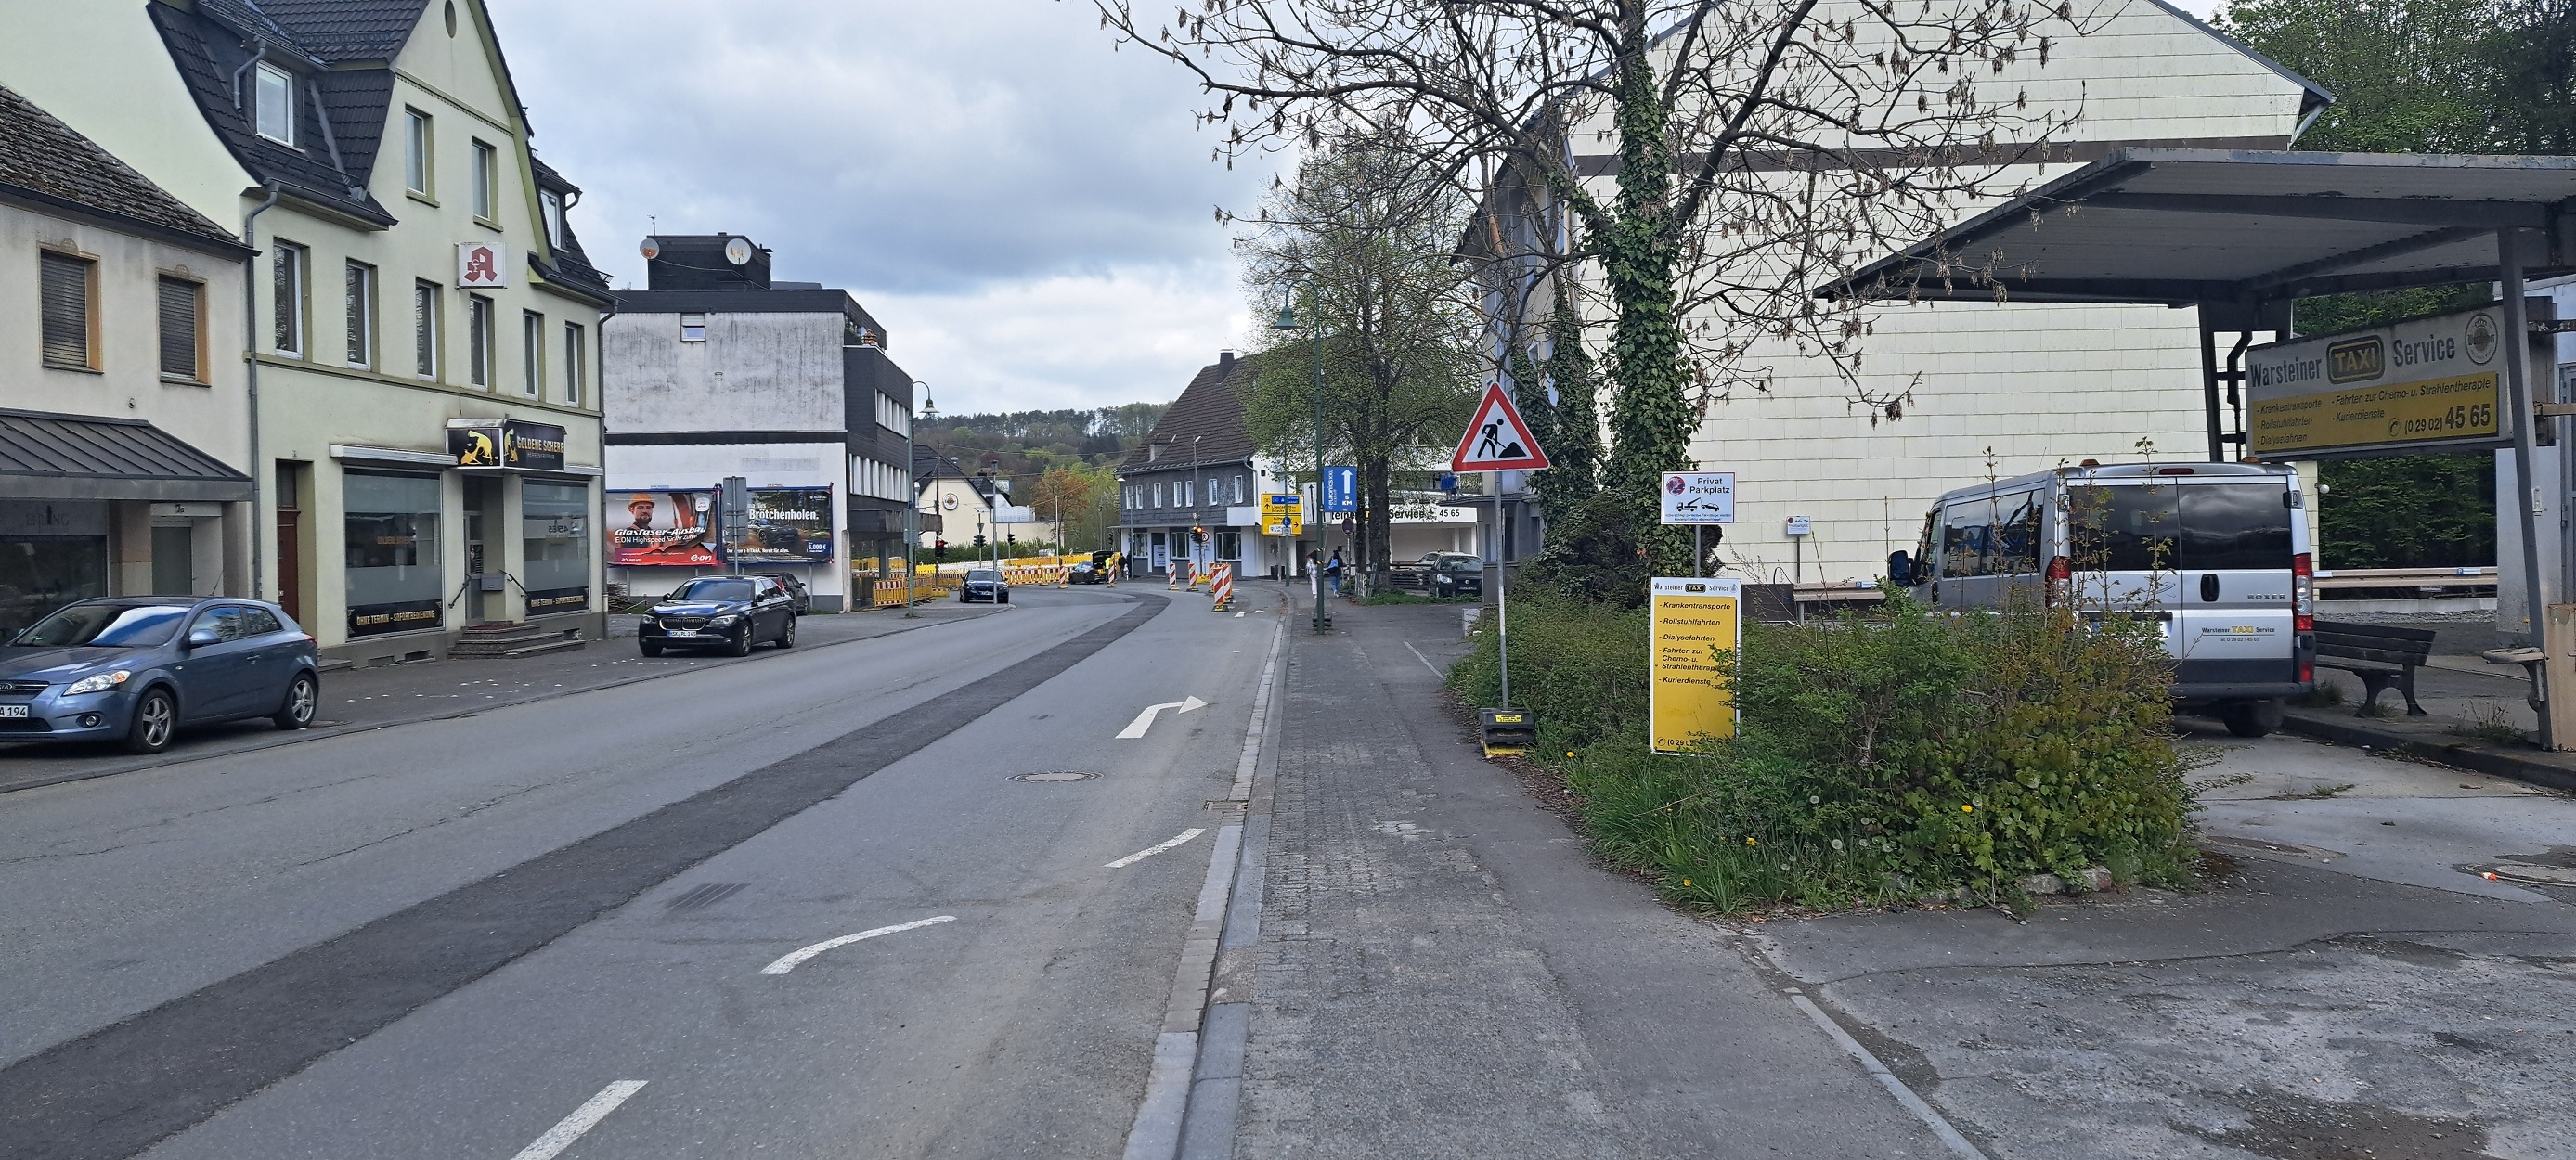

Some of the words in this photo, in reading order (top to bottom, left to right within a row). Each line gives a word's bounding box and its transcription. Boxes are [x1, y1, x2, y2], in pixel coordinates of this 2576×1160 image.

[2249, 357, 2322, 388] Warsteiner
[2334, 347, 2376, 372] TAXI
[2393, 334, 2455, 367] Service
[2419, 378, 2491, 396] Strahlentherapie
[2445, 406, 2466, 430] 45
[2470, 403, 2492, 428] 65
[516, 435, 542, 451] GOLDENE
[543, 439, 564, 454] SCHERE
[1697, 477, 1723, 485] Privat
[1689, 486, 1730, 496] Parkplatz
[748, 509, 820, 521] Brötchenholen.
[1439, 509, 1449, 518] 45
[1450, 509, 1460, 518] 65
[632, 535, 666, 545] Highspeed
[1654, 583, 1683, 591] Warsteiner
[1663, 601, 1731, 611] Krankentransporte
[1663, 617, 1721, 626] Rollstuhlfahrten
[2231, 625, 2254, 634] TAXI
[1663, 633, 1715, 642] Dialysefahrten
[1663, 647, 1690, 655] Fahrten
[1662, 654, 1690, 663] Chemo-
[7, 706, 26, 716] 194
